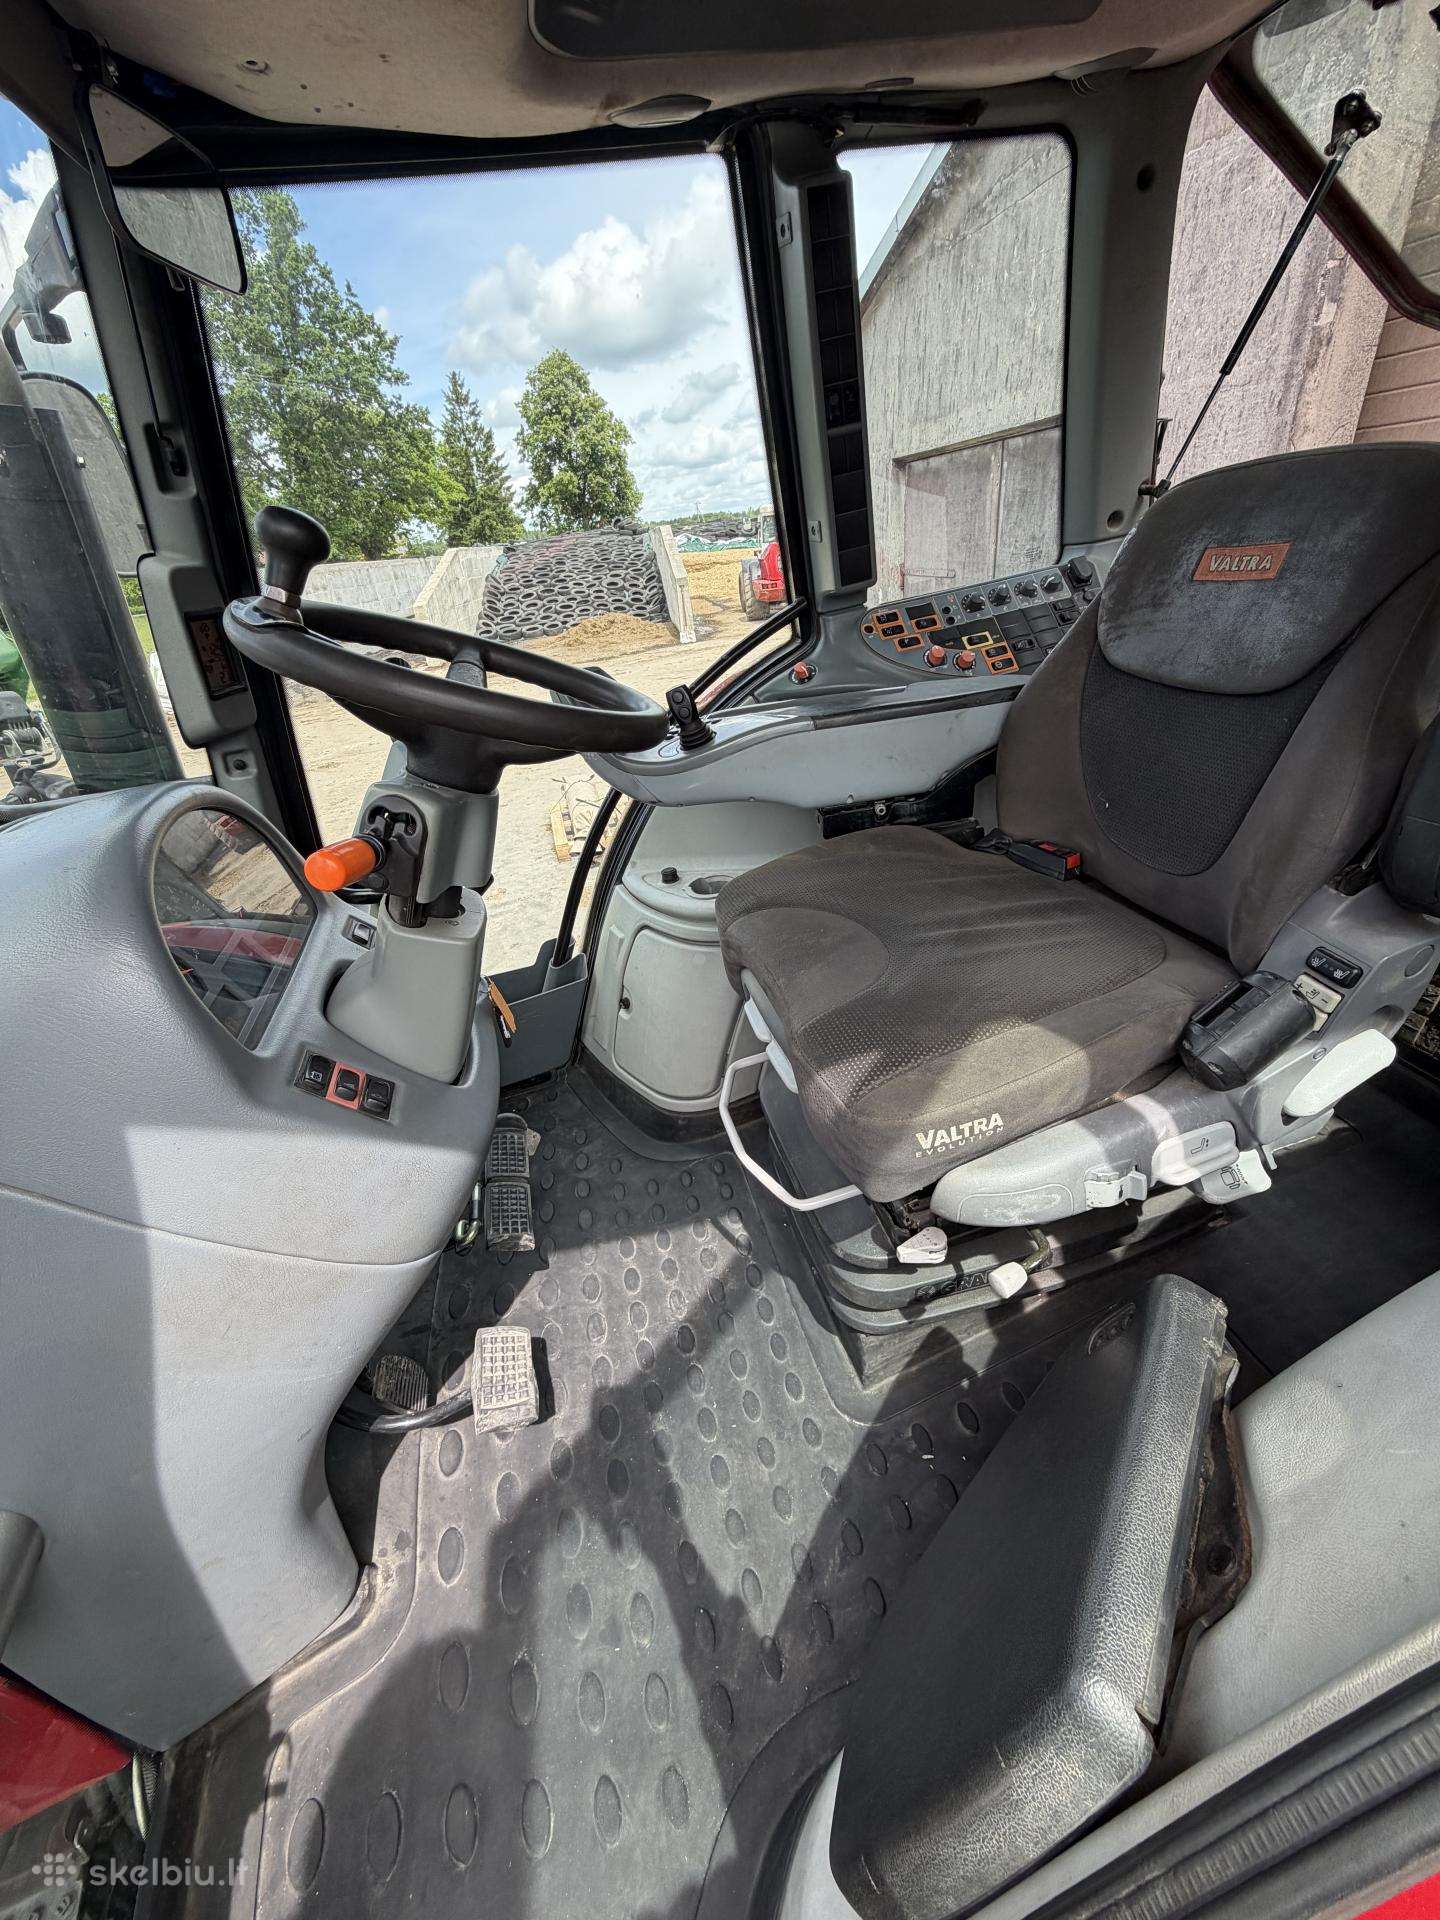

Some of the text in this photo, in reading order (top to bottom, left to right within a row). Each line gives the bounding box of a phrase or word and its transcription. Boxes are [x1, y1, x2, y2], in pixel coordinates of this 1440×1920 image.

[1208, 554, 1273, 572] VALTRA
[915, 1112, 1004, 1150] VALTRA
[915, 1126, 1004, 1158] EVOLUTION
